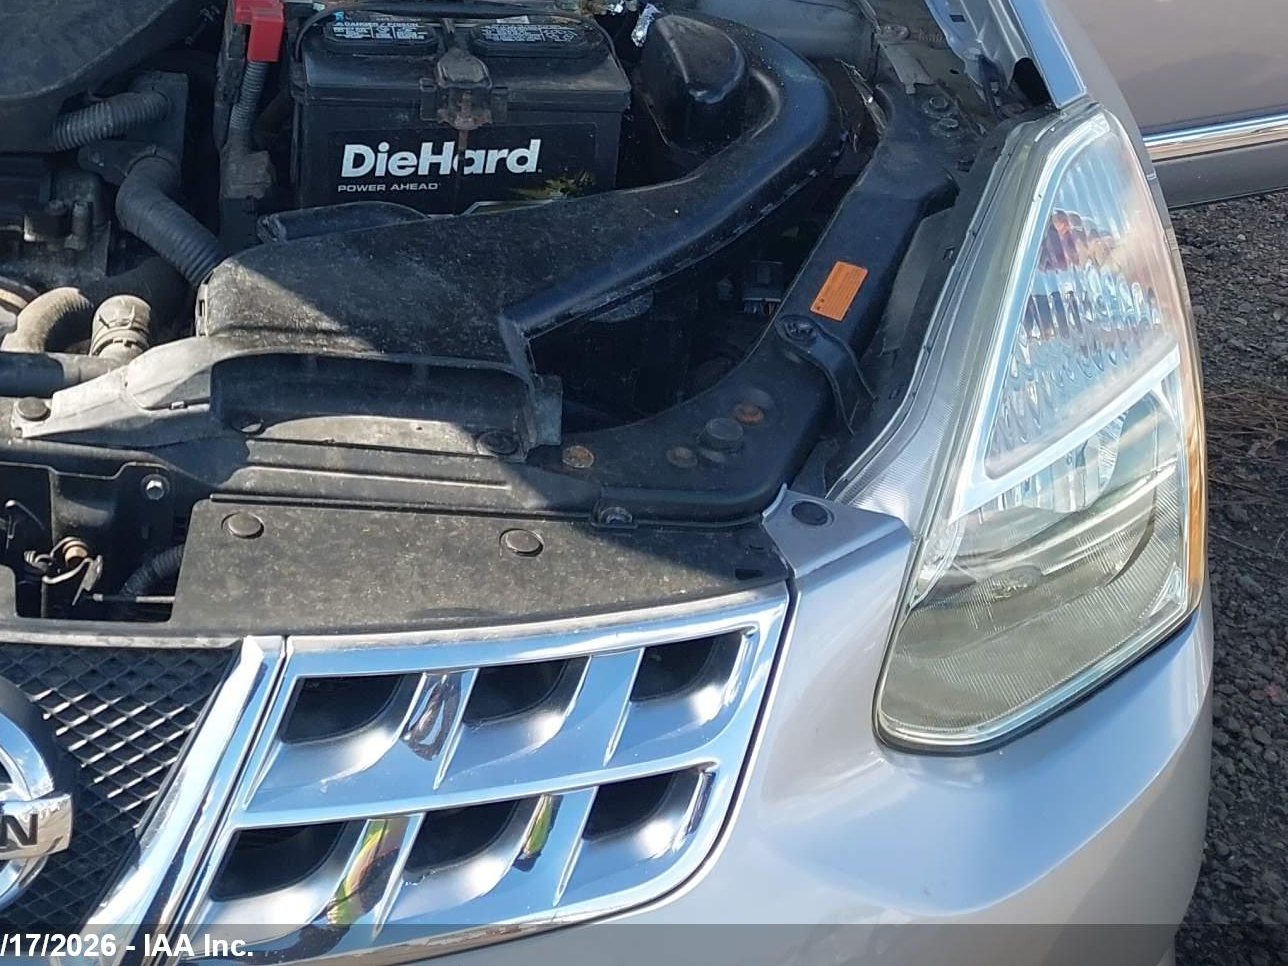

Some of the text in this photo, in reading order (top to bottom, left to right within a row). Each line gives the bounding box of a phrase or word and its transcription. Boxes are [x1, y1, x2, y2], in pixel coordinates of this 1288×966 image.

[340, 138, 542, 178] DieHard
[337, 183, 439, 193] POWER AHEAD
